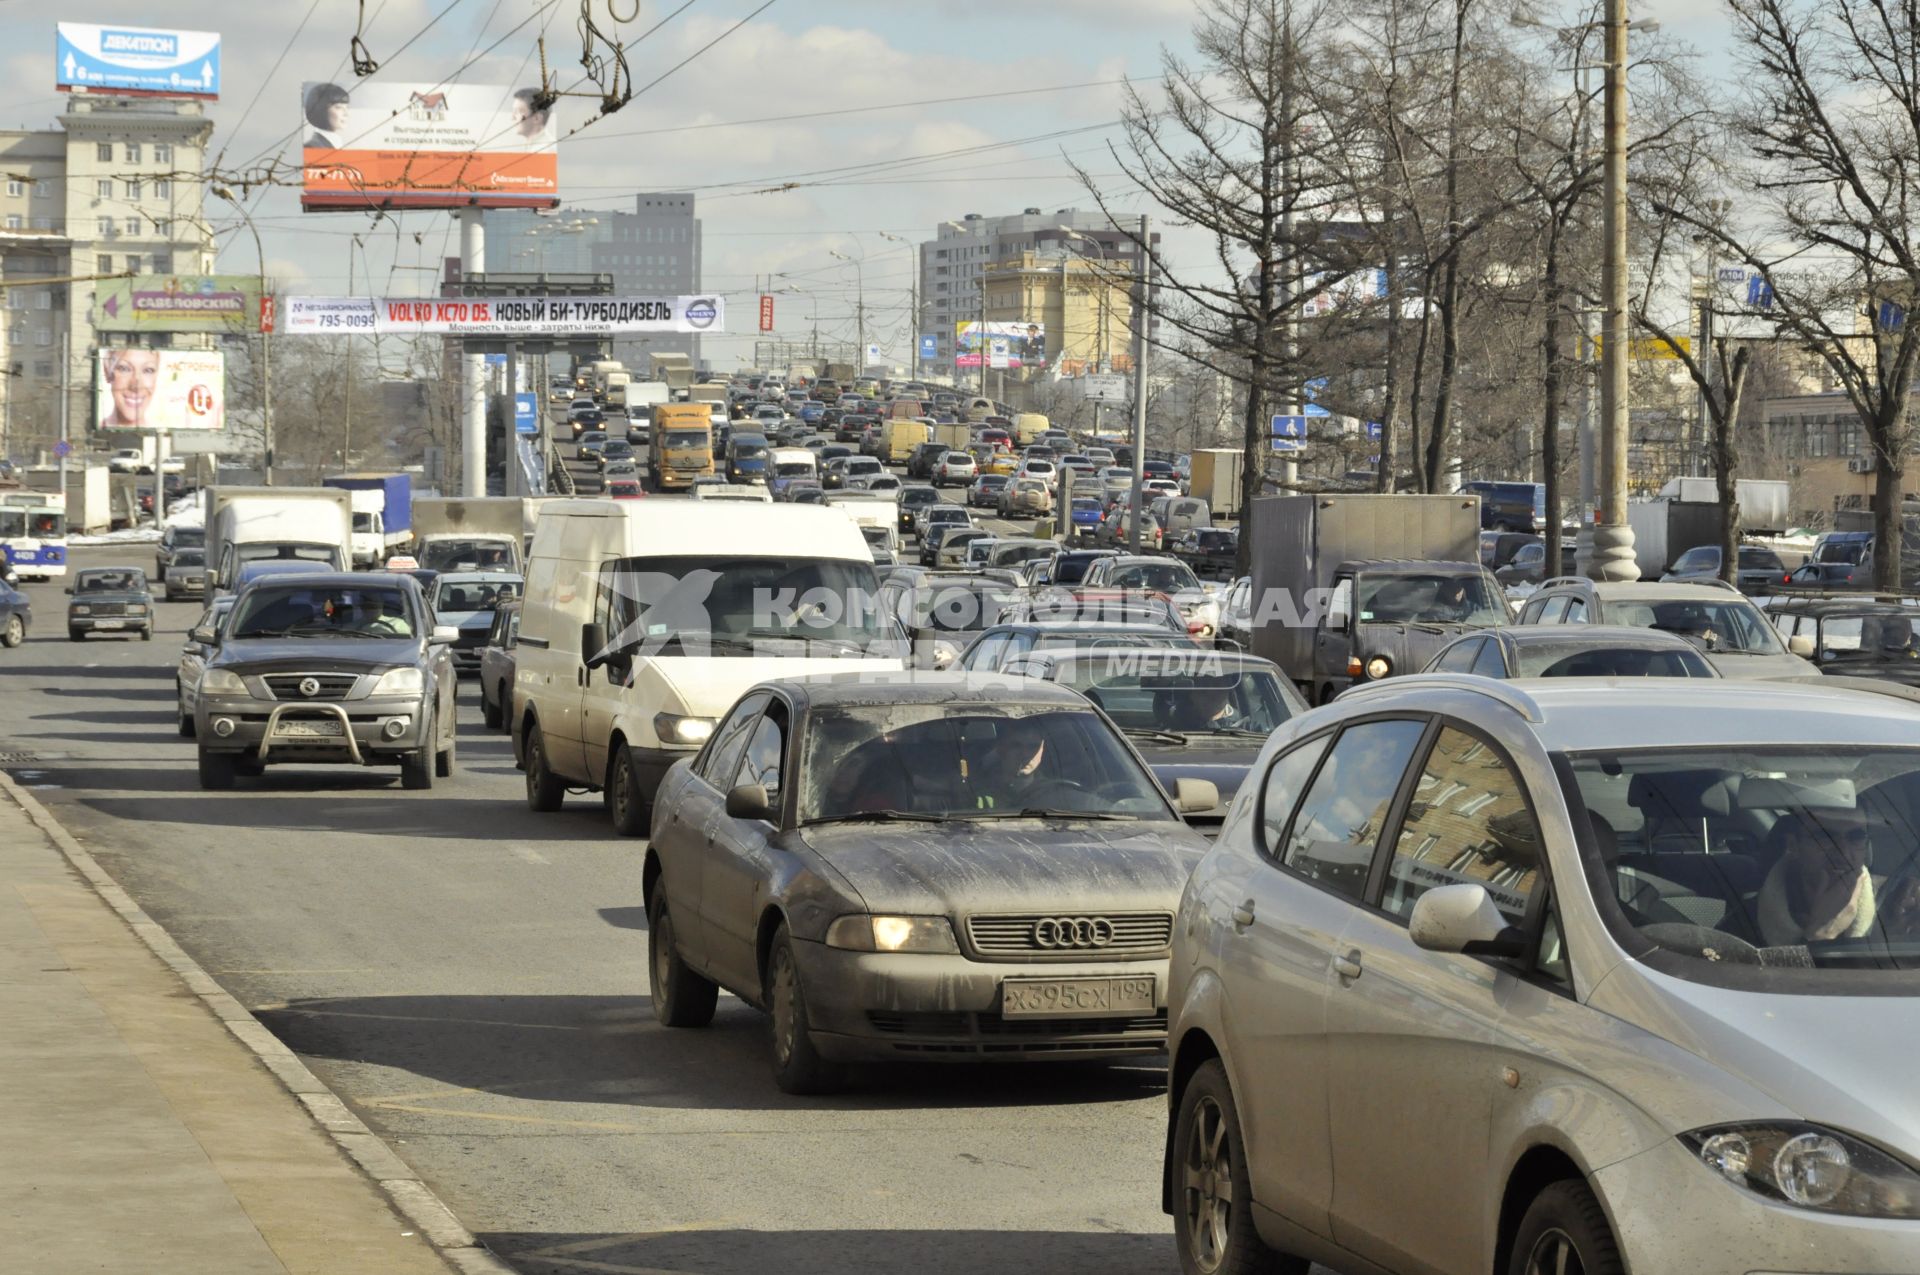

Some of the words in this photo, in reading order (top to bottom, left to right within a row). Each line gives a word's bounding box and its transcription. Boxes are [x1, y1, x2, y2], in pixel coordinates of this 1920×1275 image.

[104, 34, 174, 53] ДЕКАТЛОН
[393, 125, 434, 135] Выгодная
[436, 127, 469, 136] ипотека
[388, 302, 432, 322] VOLVO
[436, 302, 468, 322] XC70
[472, 302, 492, 322] D5.
[496, 299, 545, 321] НОВЫЙ
[549, 301, 671, 323] БИ-ТУРБОДИЗЕЛЬ
[319, 314, 375, 327] 795-0099
[449, 323, 501, 332] Мощность
[504, 324, 532, 332] выше
[541, 324, 582, 333] затраты
[585, 324, 611, 332] ниже
[1117, 981, 1147, 1000] 199
